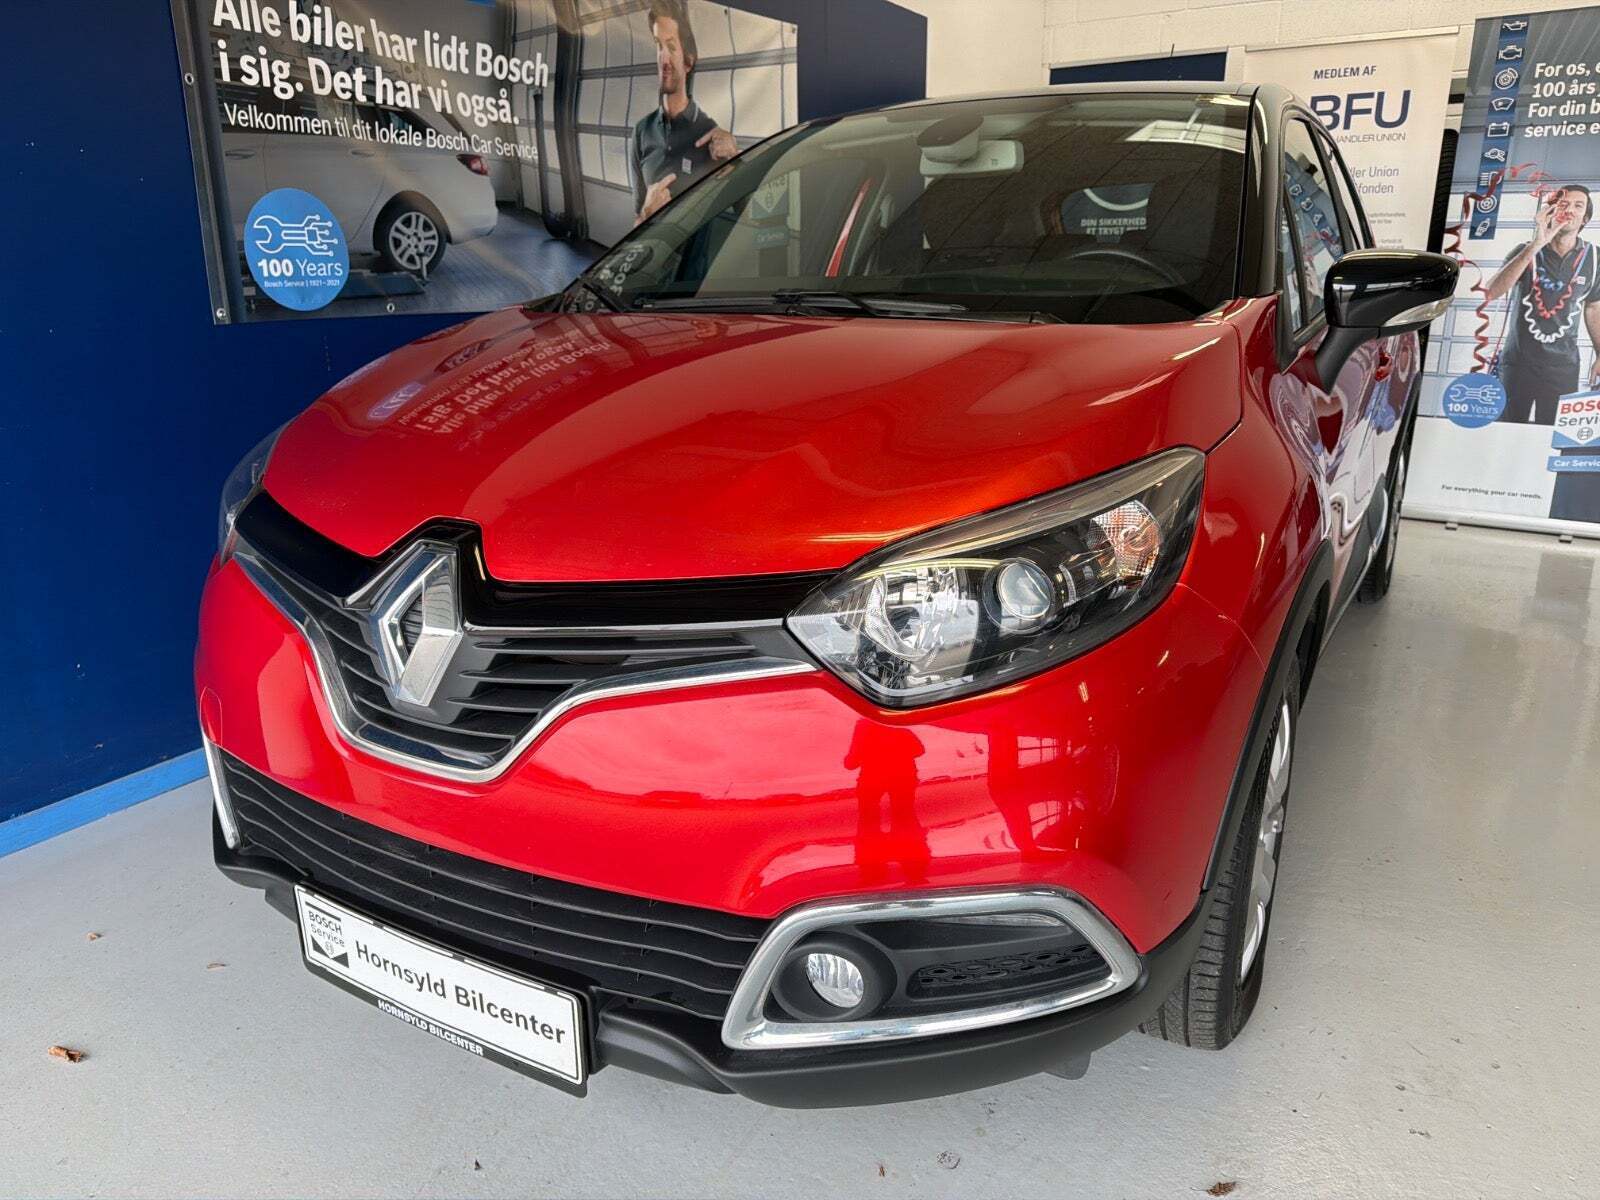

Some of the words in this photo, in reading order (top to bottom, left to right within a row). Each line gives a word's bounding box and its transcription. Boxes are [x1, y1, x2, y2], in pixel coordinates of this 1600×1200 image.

[213, 0, 281, 37] Alle
[289, 0, 366, 53] biler
[370, 18, 417, 64] har
[424, 30, 469, 75] lidt
[475, 43, 549, 87] Bosch
[1313, 66, 1360, 80] MEDLEM
[1362, 65, 1377, 76] AF
[1534, 62, 1564, 78] For
[1566, 62, 1591, 77] os,
[217, 39, 231, 82] i
[240, 46, 304, 100] sig.
[307, 57, 367, 104] Det
[375, 66, 422, 110] har
[428, 79, 453, 114] vi
[456, 87, 519, 127] også.
[1532, 81, 1566, 98] 100
[1568, 79, 1597, 96] års
[1528, 103, 1557, 118] For
[1559, 100, 1587, 116] din
[223, 102, 332, 136] Velkommen
[334, 117, 350, 138] til
[352, 117, 373, 142] dit
[375, 120, 422, 147] lokale
[426, 128, 469, 152] Bosch
[471, 134, 492, 153] Car
[494, 136, 538, 159] Service
[1336, 133, 1375, 143] ANDLER
[1376, 132, 1407, 142] UNION
[1524, 120, 1587, 137] service
[1369, 165, 1400, 178] Union
[1357, 181, 1394, 193] fonden
[257, 258, 294, 278] 100
[295, 258, 344, 277] Years
[1448, 402, 1469, 413] 100
[1470, 403, 1499, 415] Years
[1558, 412, 1600, 427] Servi
[308, 910, 342, 936] BOSCH
[311, 923, 345, 948] Service
[354, 940, 447, 998] Hornsyld
[455, 985, 566, 1044] Bilcenter
[378, 999, 428, 1032] HORNSYLD
[429, 1023, 485, 1057] BILCENTER
